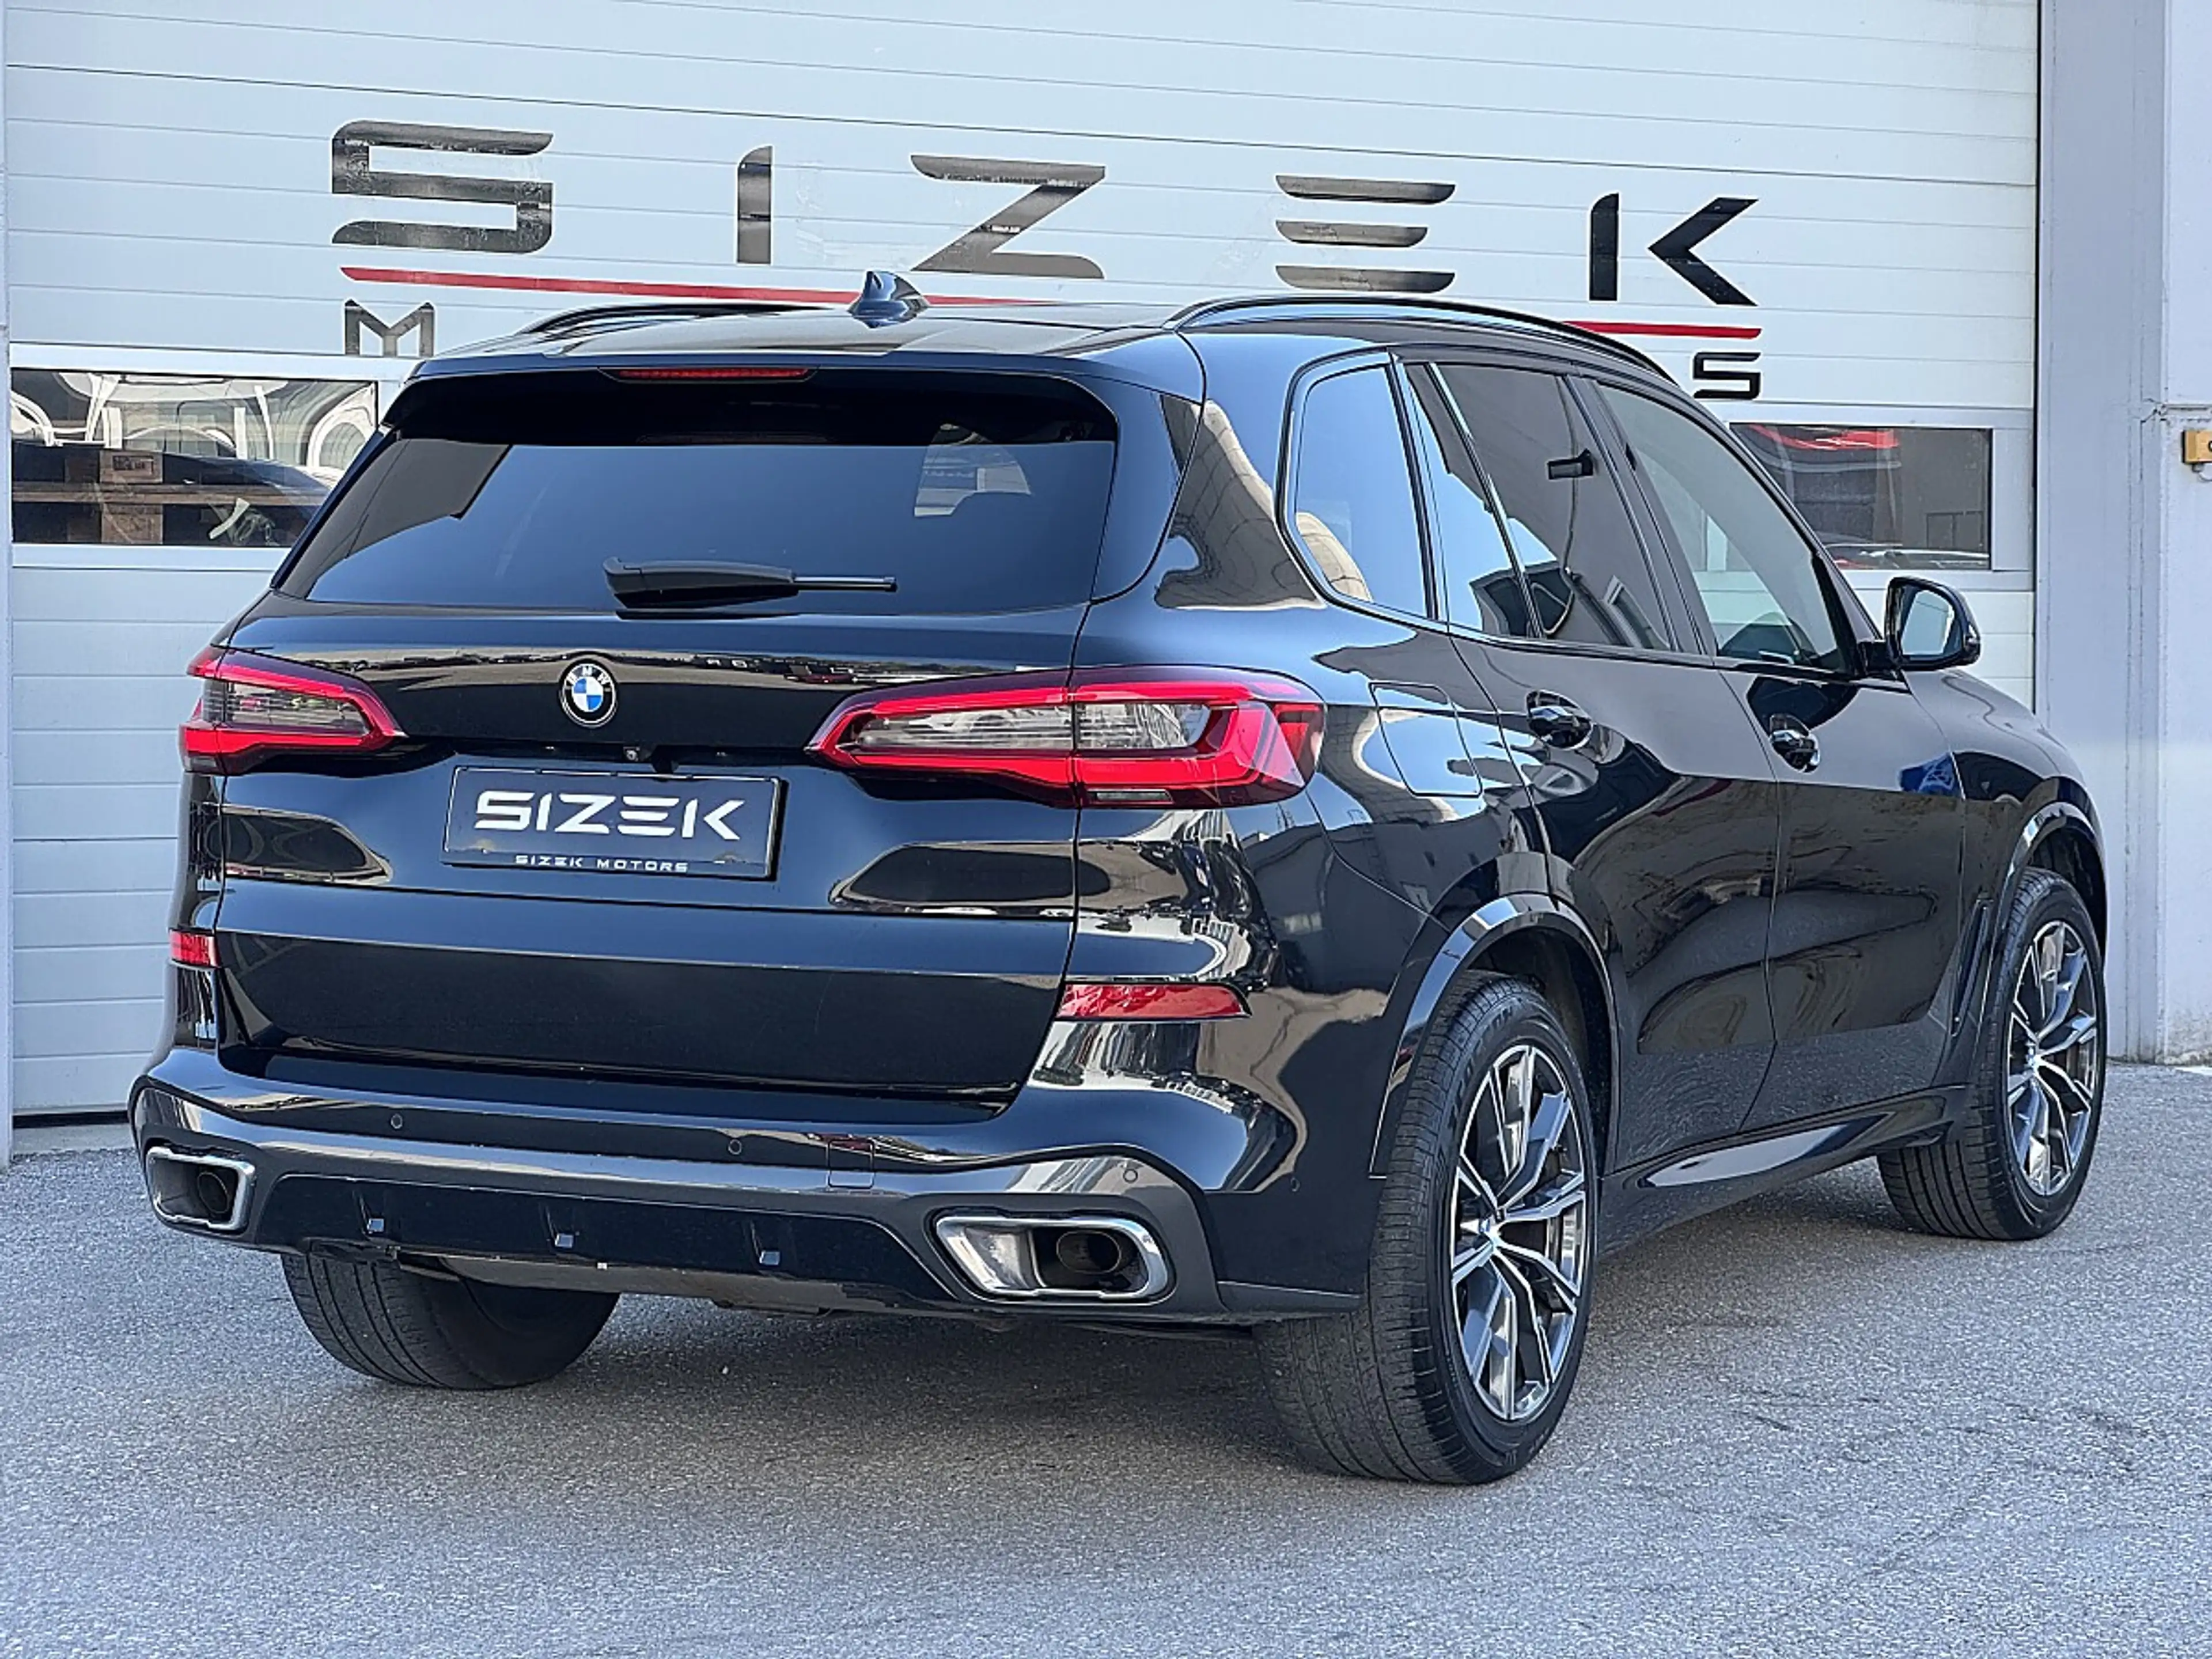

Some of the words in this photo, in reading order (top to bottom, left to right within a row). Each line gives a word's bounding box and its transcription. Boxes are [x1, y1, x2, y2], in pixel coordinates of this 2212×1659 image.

[332, 119, 1759, 306] SIZEK
[474, 790, 745, 840] SIZEK
[516, 855, 584, 868] SIZEK
[597, 858, 688, 873] MOTORS
